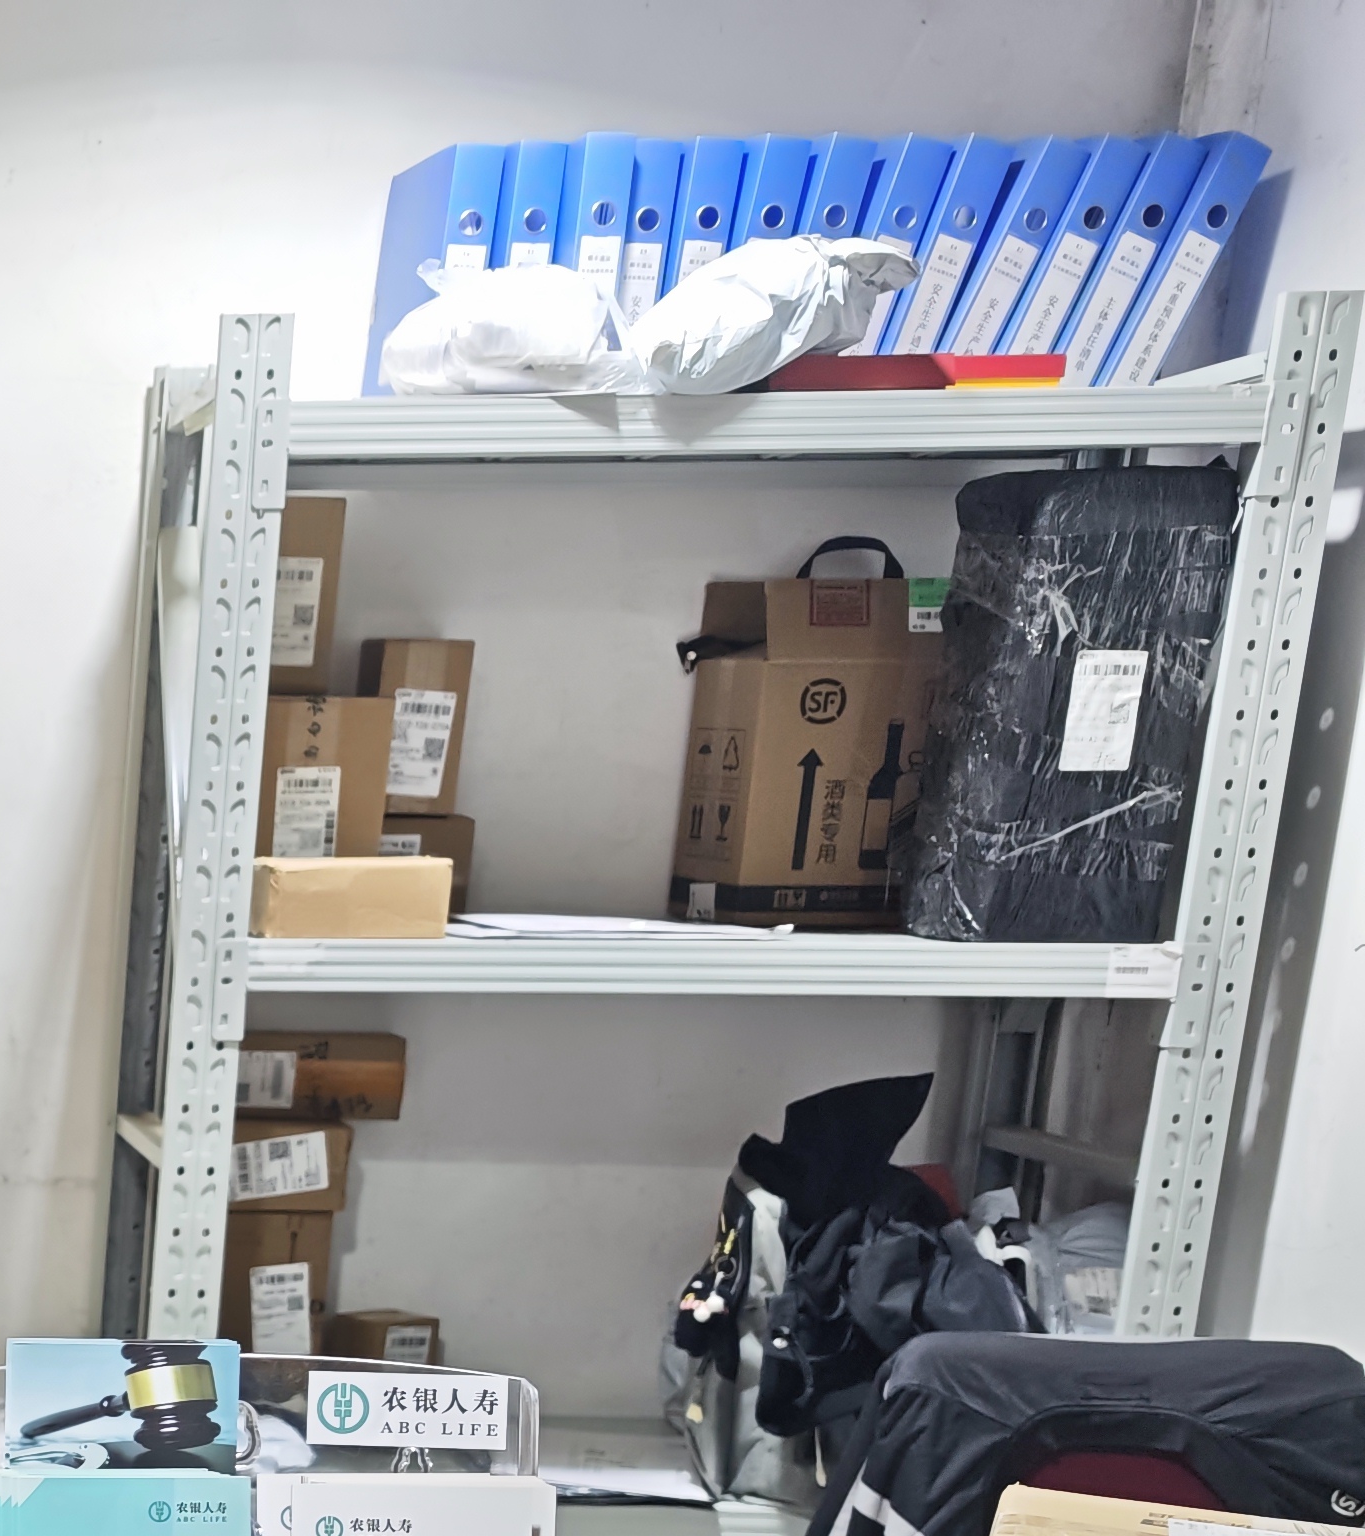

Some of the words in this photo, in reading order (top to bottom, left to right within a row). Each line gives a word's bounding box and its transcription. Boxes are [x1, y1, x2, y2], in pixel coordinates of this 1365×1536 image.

[815, 778, 846, 865] 酒类专用
[381, 1386, 499, 1416] 农银人寿
[381, 1421, 427, 1435] ABC
[441, 1422, 499, 1437] LIFE
[175, 1501, 228, 1515] 农银人寿
[176, 1515, 196, 1523] ABC
[203, 1515, 228, 1523] LIFE
[349, 1517, 413, 1534] 农银人寿
